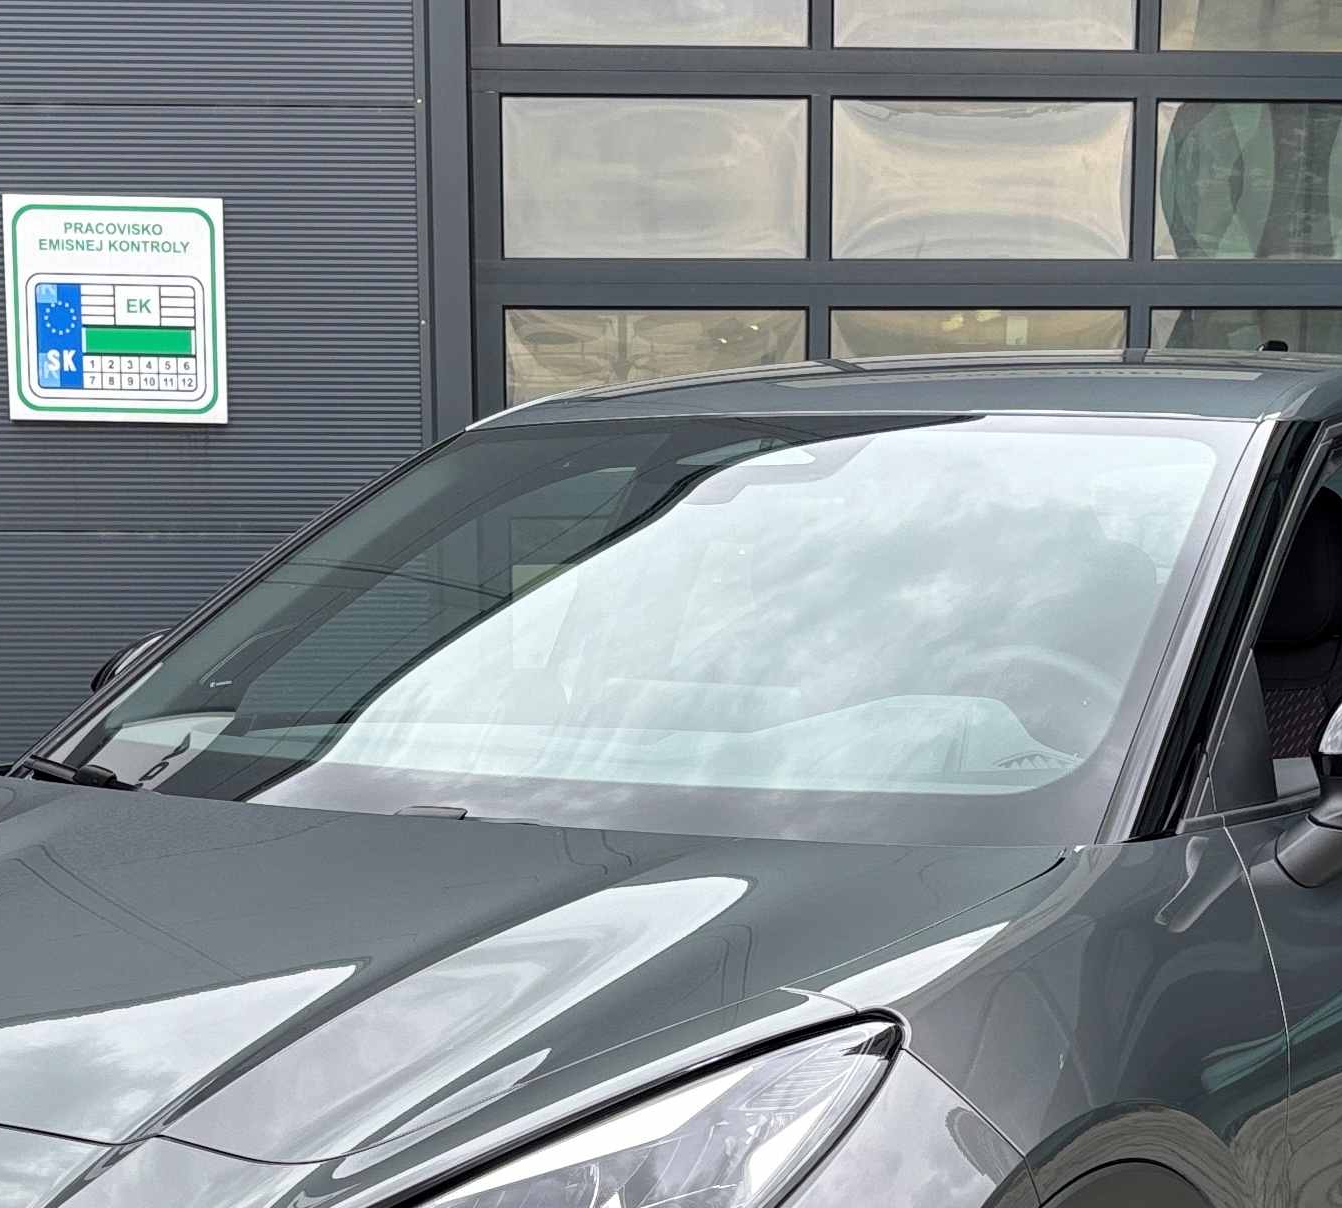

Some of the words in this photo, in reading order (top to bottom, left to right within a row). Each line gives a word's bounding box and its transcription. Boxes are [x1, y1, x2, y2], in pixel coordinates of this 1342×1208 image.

[63, 222, 163, 236] PRACOVISKO
[38, 238, 104, 251] EMISNEJ
[108, 239, 190, 254] KONTROLY
[126, 298, 152, 314] EK
[47, 348, 77, 372] SK
[108, 360, 115, 368] 2
[127, 360, 133, 369] 3
[145, 360, 152, 369] 4
[164, 360, 171, 370] 5
[183, 361, 190, 370] 6
[89, 375, 96, 384] 7
[108, 376, 115, 385] 8
[127, 376, 134, 386] 9
[144, 376, 156, 386] 10
[164, 377, 174, 387] 11
[182, 378, 194, 388] 12
